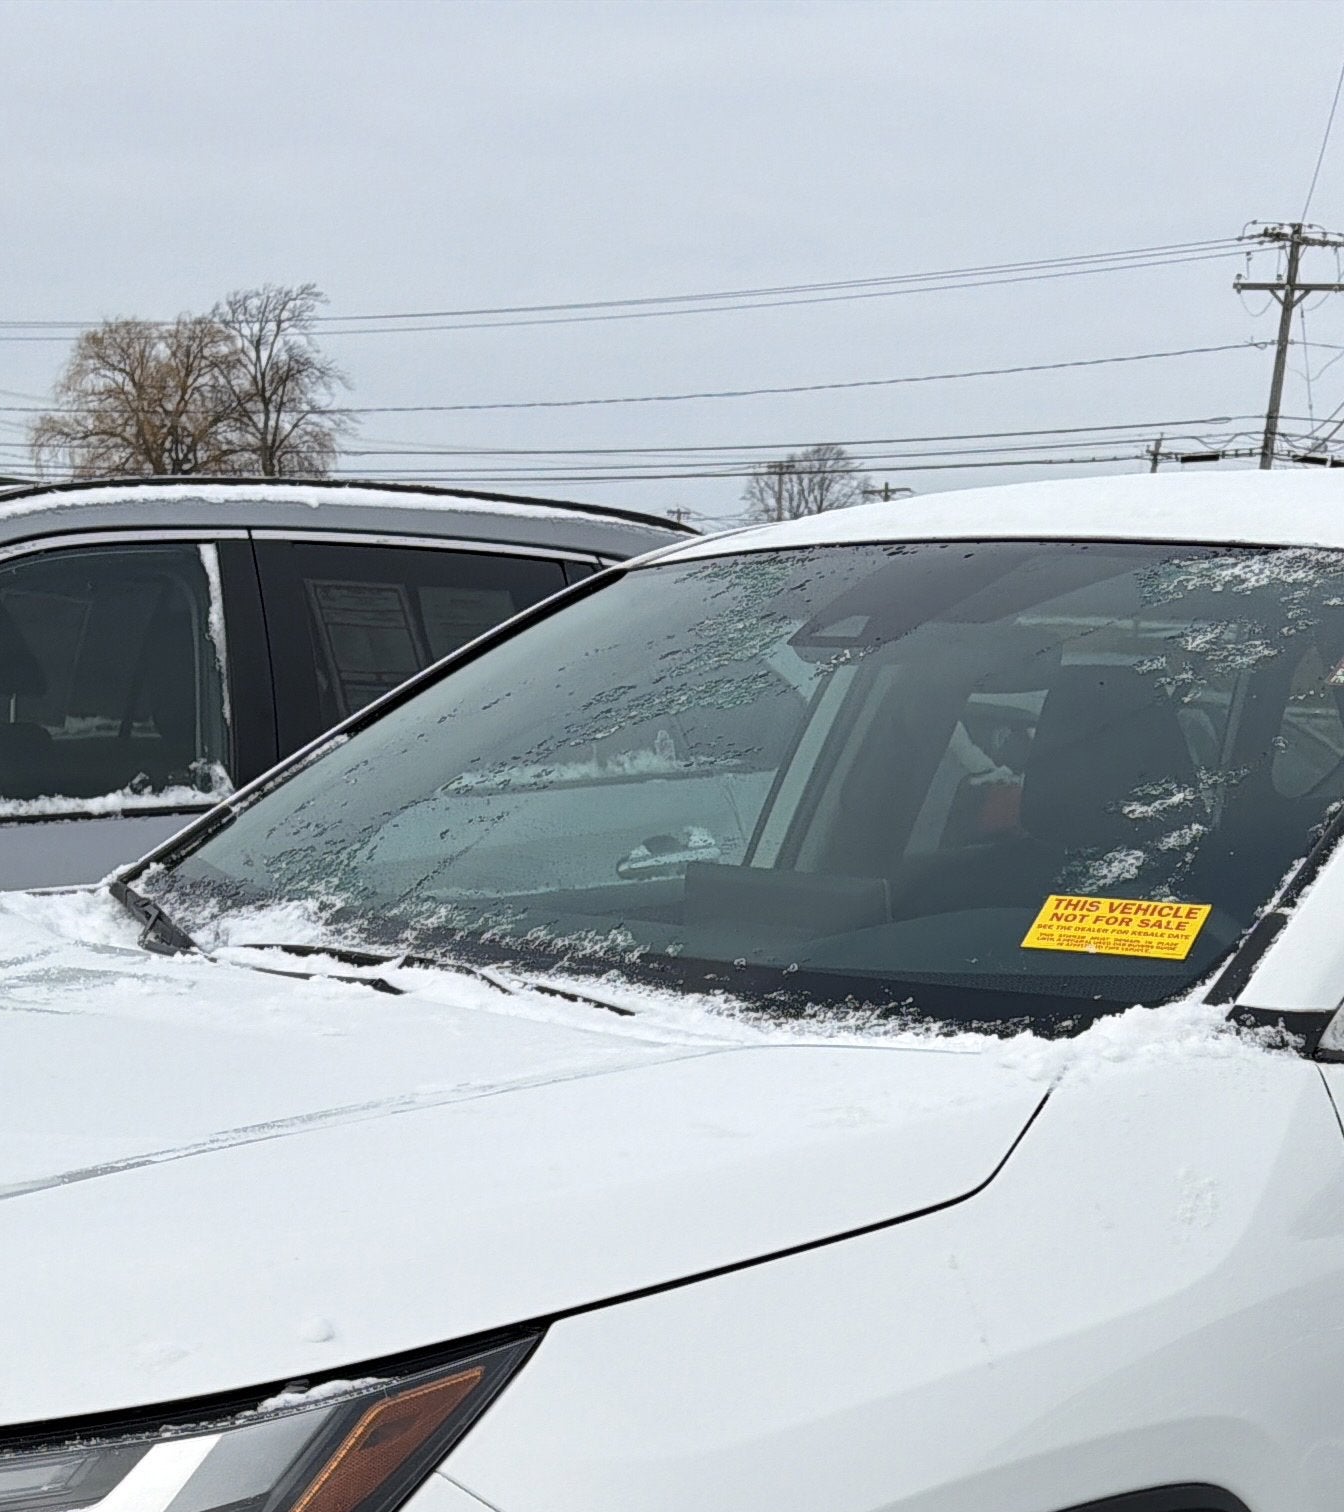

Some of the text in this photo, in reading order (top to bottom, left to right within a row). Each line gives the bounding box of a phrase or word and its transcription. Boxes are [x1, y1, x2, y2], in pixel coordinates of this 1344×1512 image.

[1054, 898, 1202, 919] THIS VEHICLE
[1049, 912, 1190, 931] NOT FOR SALE
